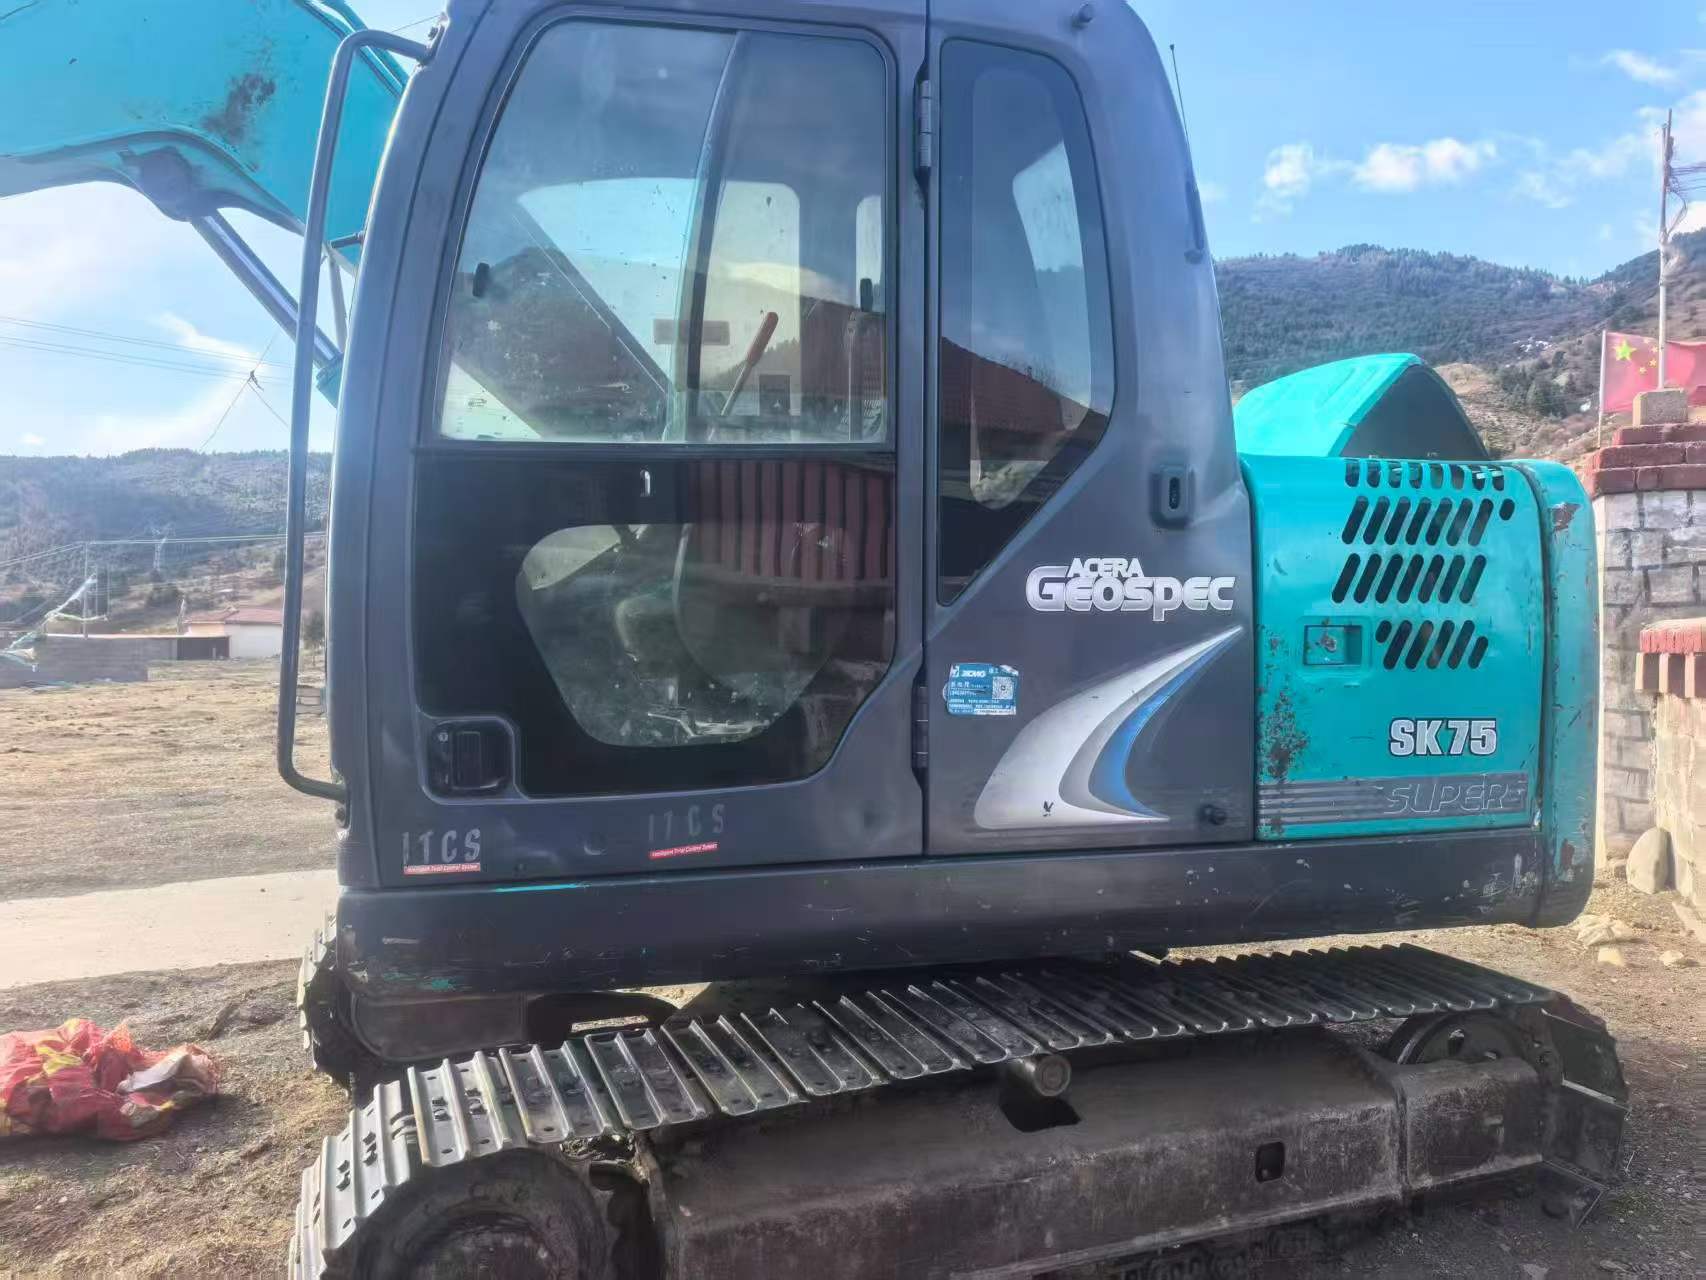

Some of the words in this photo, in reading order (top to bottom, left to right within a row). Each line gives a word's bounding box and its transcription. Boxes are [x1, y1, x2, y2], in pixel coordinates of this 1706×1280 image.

[1066, 557, 1145, 578] ACERA
[1388, 717, 1498, 757] SK75
[401, 828, 481, 864] ITCS
